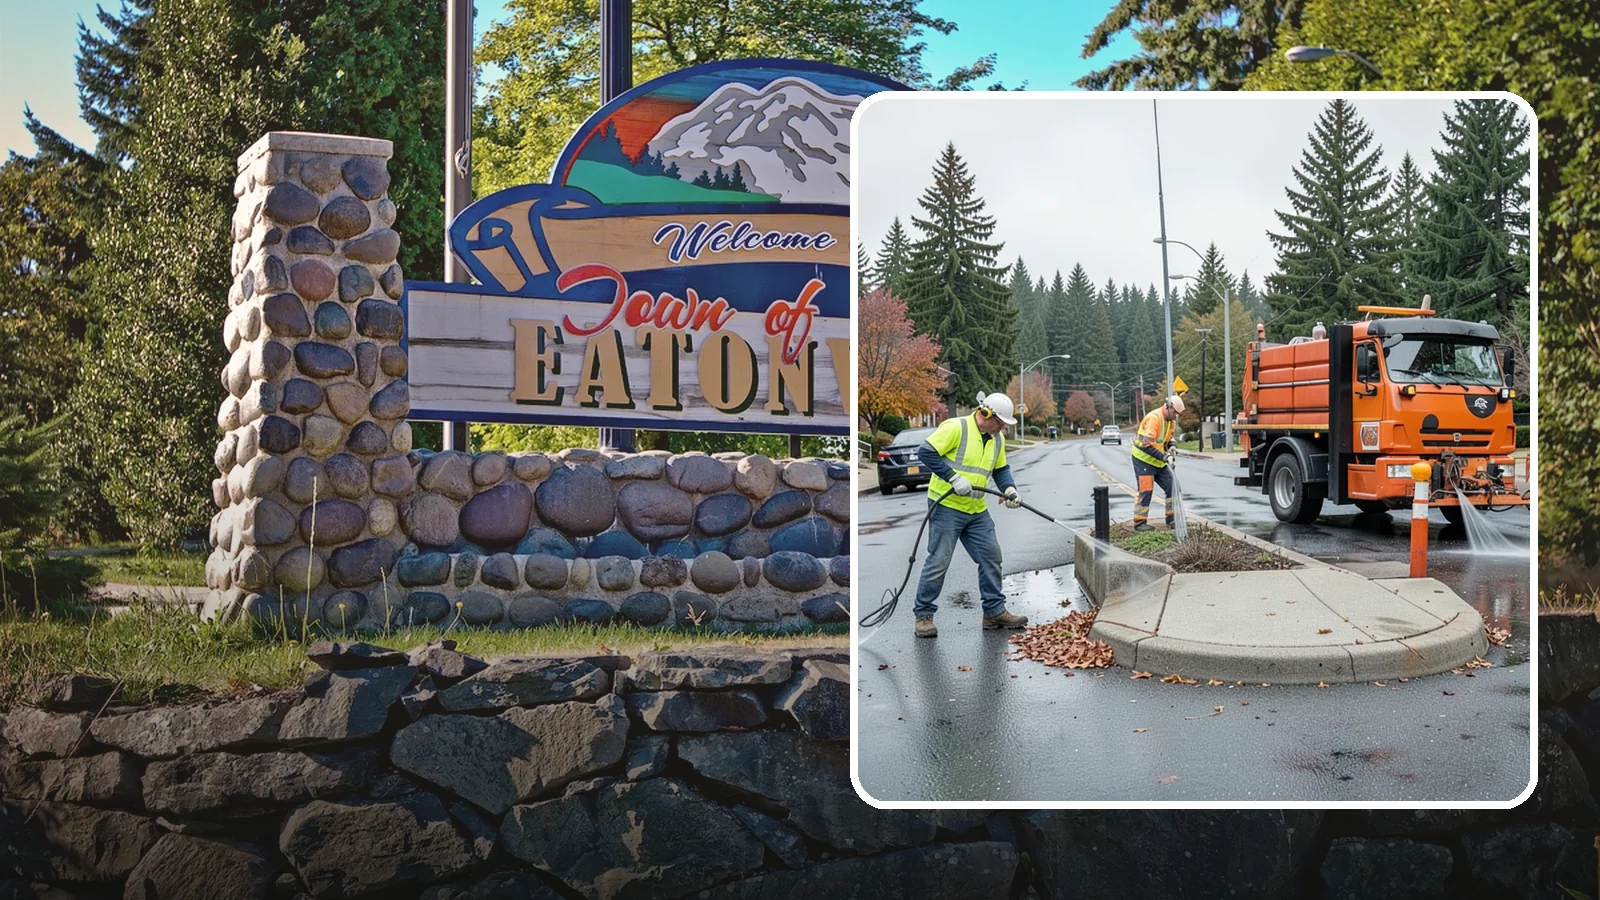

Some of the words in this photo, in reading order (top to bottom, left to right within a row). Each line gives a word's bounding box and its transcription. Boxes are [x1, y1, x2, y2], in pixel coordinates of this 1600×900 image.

[653, 221, 836, 262] Welcome
[556, 264, 737, 336] Town
[765, 278, 826, 365] of
